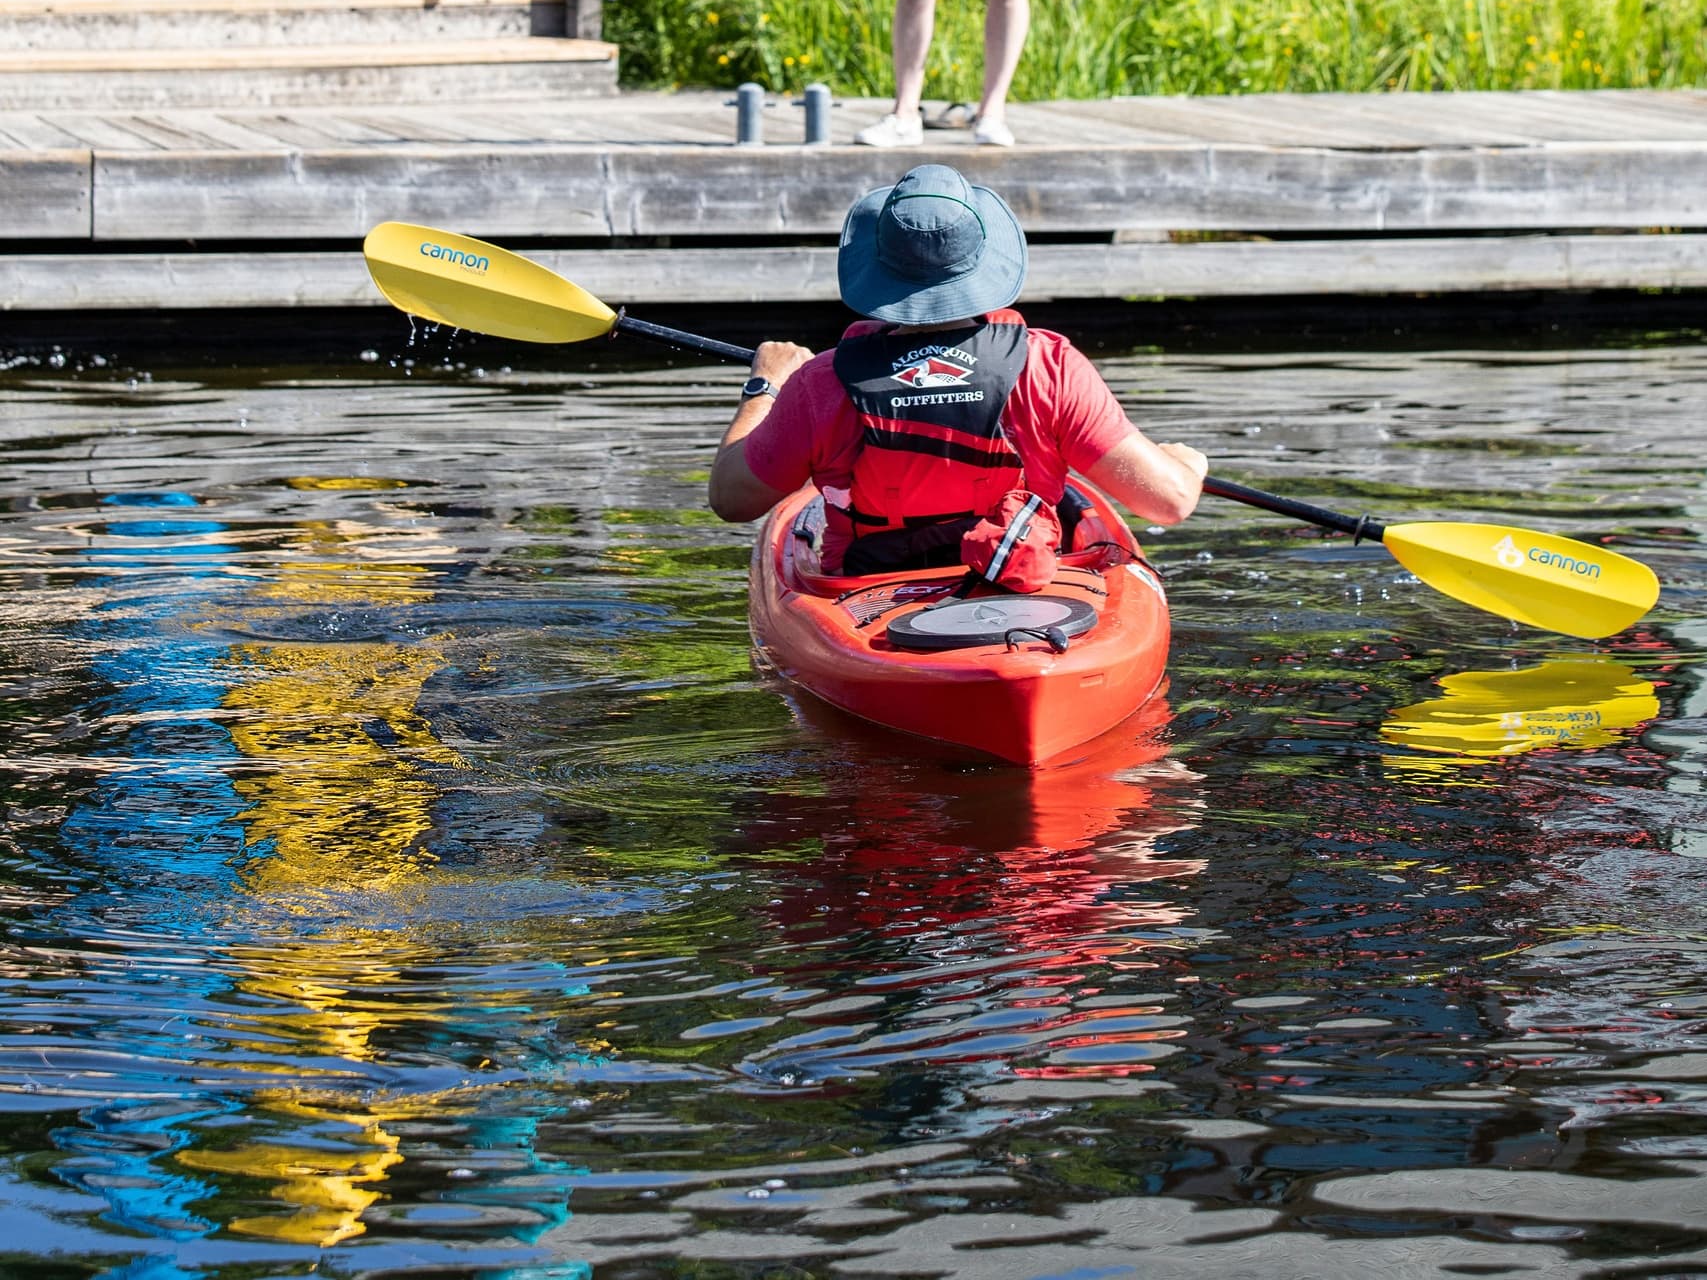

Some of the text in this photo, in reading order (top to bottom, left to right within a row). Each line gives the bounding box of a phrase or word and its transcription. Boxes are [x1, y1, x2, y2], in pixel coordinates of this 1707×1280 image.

[420, 242, 489, 271] cannon
[891, 345, 979, 371] ALGONQUIN
[891, 390, 984, 408] OUTFITTERS
[1528, 547, 1600, 578] cannon
